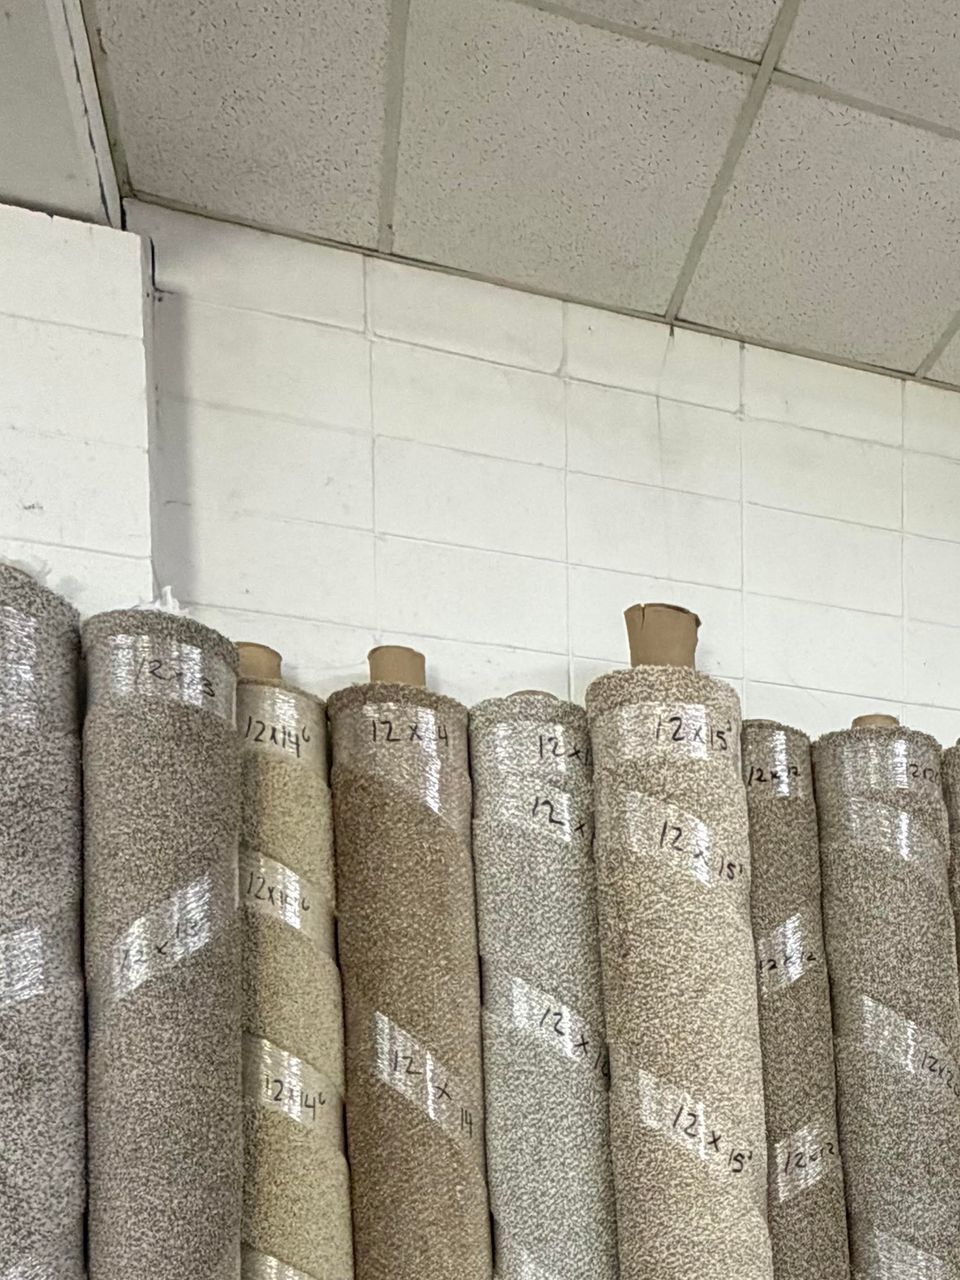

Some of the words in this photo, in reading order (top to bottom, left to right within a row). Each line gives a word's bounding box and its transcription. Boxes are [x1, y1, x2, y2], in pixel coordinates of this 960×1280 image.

[371, 720, 401, 743] 12
[408, 721, 424, 743] x
[655, 715, 684, 743] 12
[538, 735, 560, 760] 12
[531, 799, 565, 826] 12
[574, 820, 587, 839] x
[660, 820, 684, 852] 12
[539, 1007, 566, 1036] 12
[574, 1034, 590, 1055] x
[392, 1050, 424, 1076] 12
[435, 1080, 452, 1100] x
[459, 1107, 475, 1139] 14
[671, 1105, 699, 1138] 12
[706, 1129, 723, 1152] x
